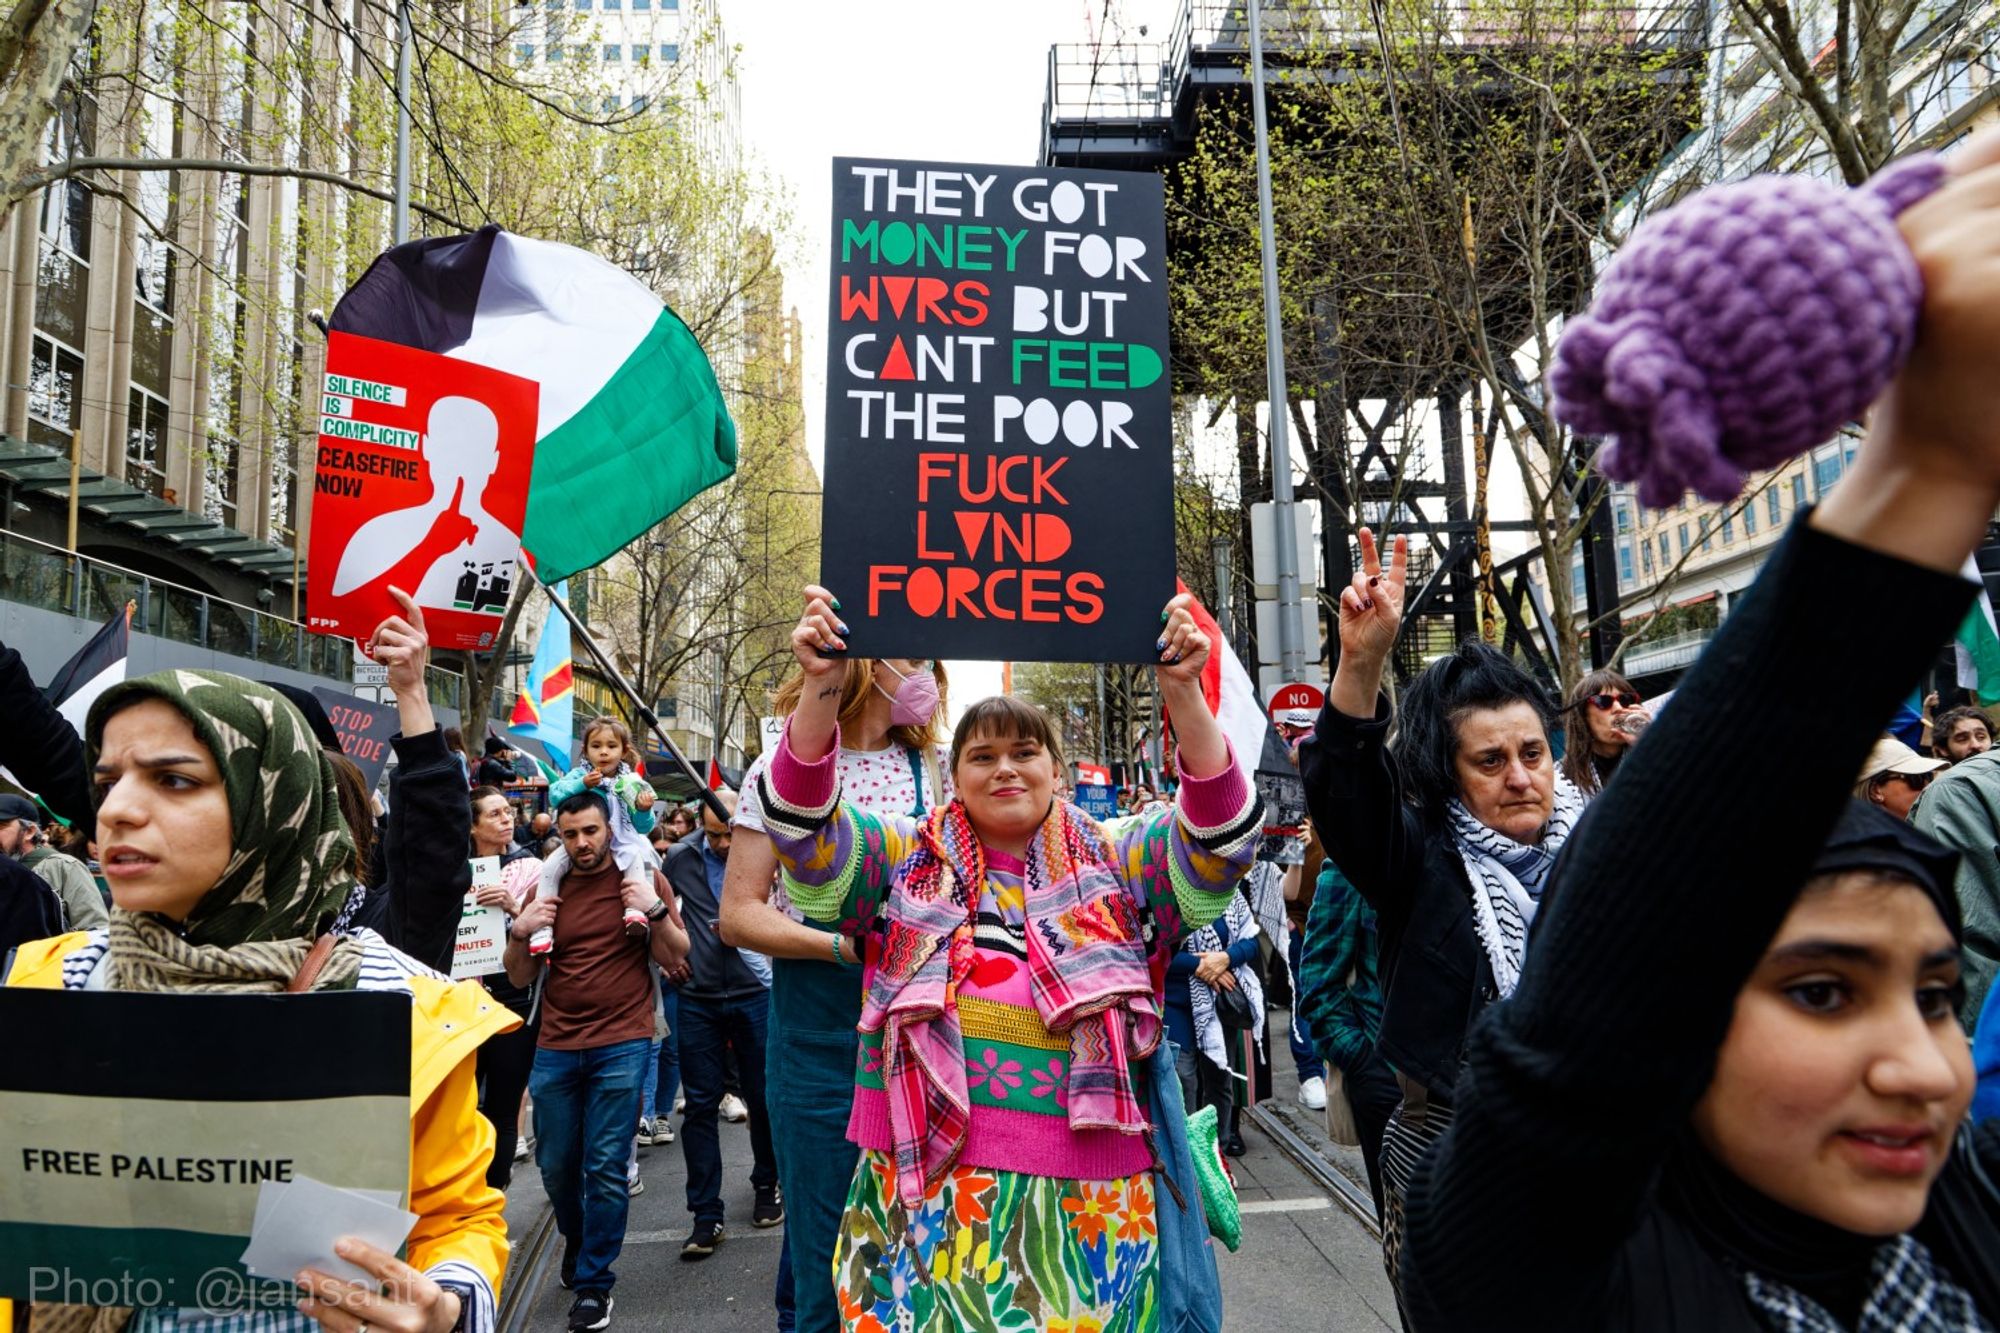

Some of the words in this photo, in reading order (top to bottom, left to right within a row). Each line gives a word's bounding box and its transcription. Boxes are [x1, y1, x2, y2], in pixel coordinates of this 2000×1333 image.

[852, 166, 997, 217] THEY
[1012, 178, 1118, 226] GOT
[842, 219, 1028, 271] MONEY
[1044, 231, 1151, 282] FOR
[1013, 286, 1127, 338] BUT
[845, 333, 995, 383] CANT
[1013, 339, 1163, 389] FEED
[325, 397, 341, 414] IS
[328, 376, 392, 402] SILENCE
[323, 418, 418, 449] COMPLICITY
[847, 390, 965, 443] THE
[994, 395, 1139, 449] POOR
[317, 446, 419, 481] CEASEFIRE
[918, 453, 1069, 505] FUCK
[315, 472, 362, 498] NOW
[869, 565, 1104, 624] FORCES
[310, 617, 339, 627] FPP
[1289, 692, 1309, 706] NO
[329, 705, 372, 732] STOP
[1087, 788, 1107, 799] YOUR
[457, 926, 478, 936] ERY
[22, 1148, 102, 1176] FREE
[112, 1154, 294, 1184] PALESTINE
